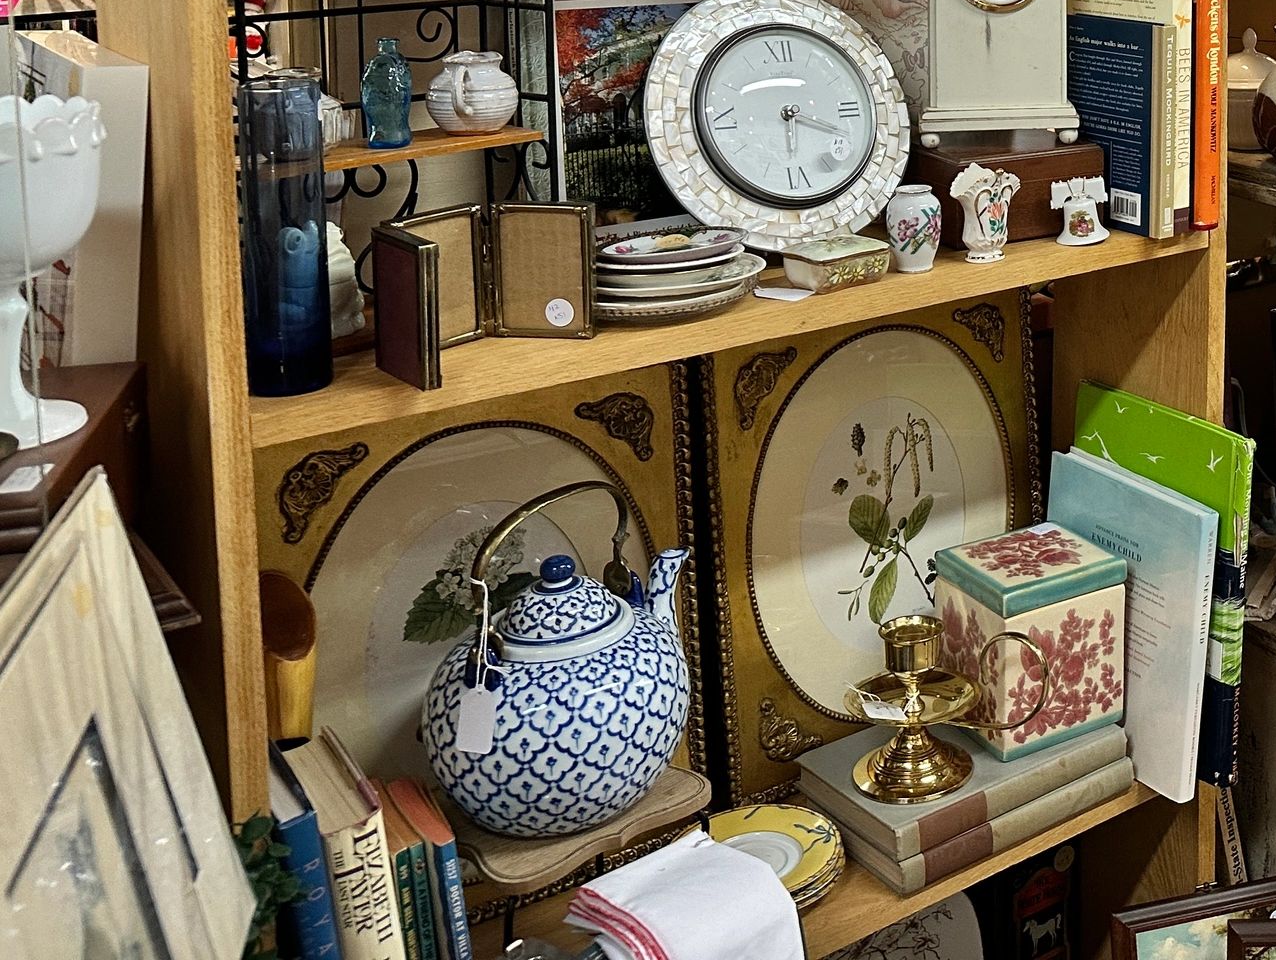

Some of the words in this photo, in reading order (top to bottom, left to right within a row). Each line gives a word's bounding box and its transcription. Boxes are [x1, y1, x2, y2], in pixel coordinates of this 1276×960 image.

[1209, 33, 1221, 47] of
[1165, 34, 1175, 84] TEQUILA
[1178, 47, 1191, 84] BEES
[1206, 45, 1220, 85] London
[1178, 92, 1190, 106] IN
[1164, 88, 1174, 167] MOCKINGBIRD
[1177, 110, 1190, 169] AMERICA
[1091, 532, 1117, 552] ENEMY
[1117, 545, 1142, 563] CHILD
[1239, 554, 1249, 589] Maine
[1201, 575, 1210, 611] ENEMY
[333, 865, 375, 935] TAYLOR
[352, 827, 394, 944] ELIZABETH
[449, 884, 464, 919] DOCTOR
[455, 921, 466, 932] AT
[457, 934, 470, 959] VILLA
